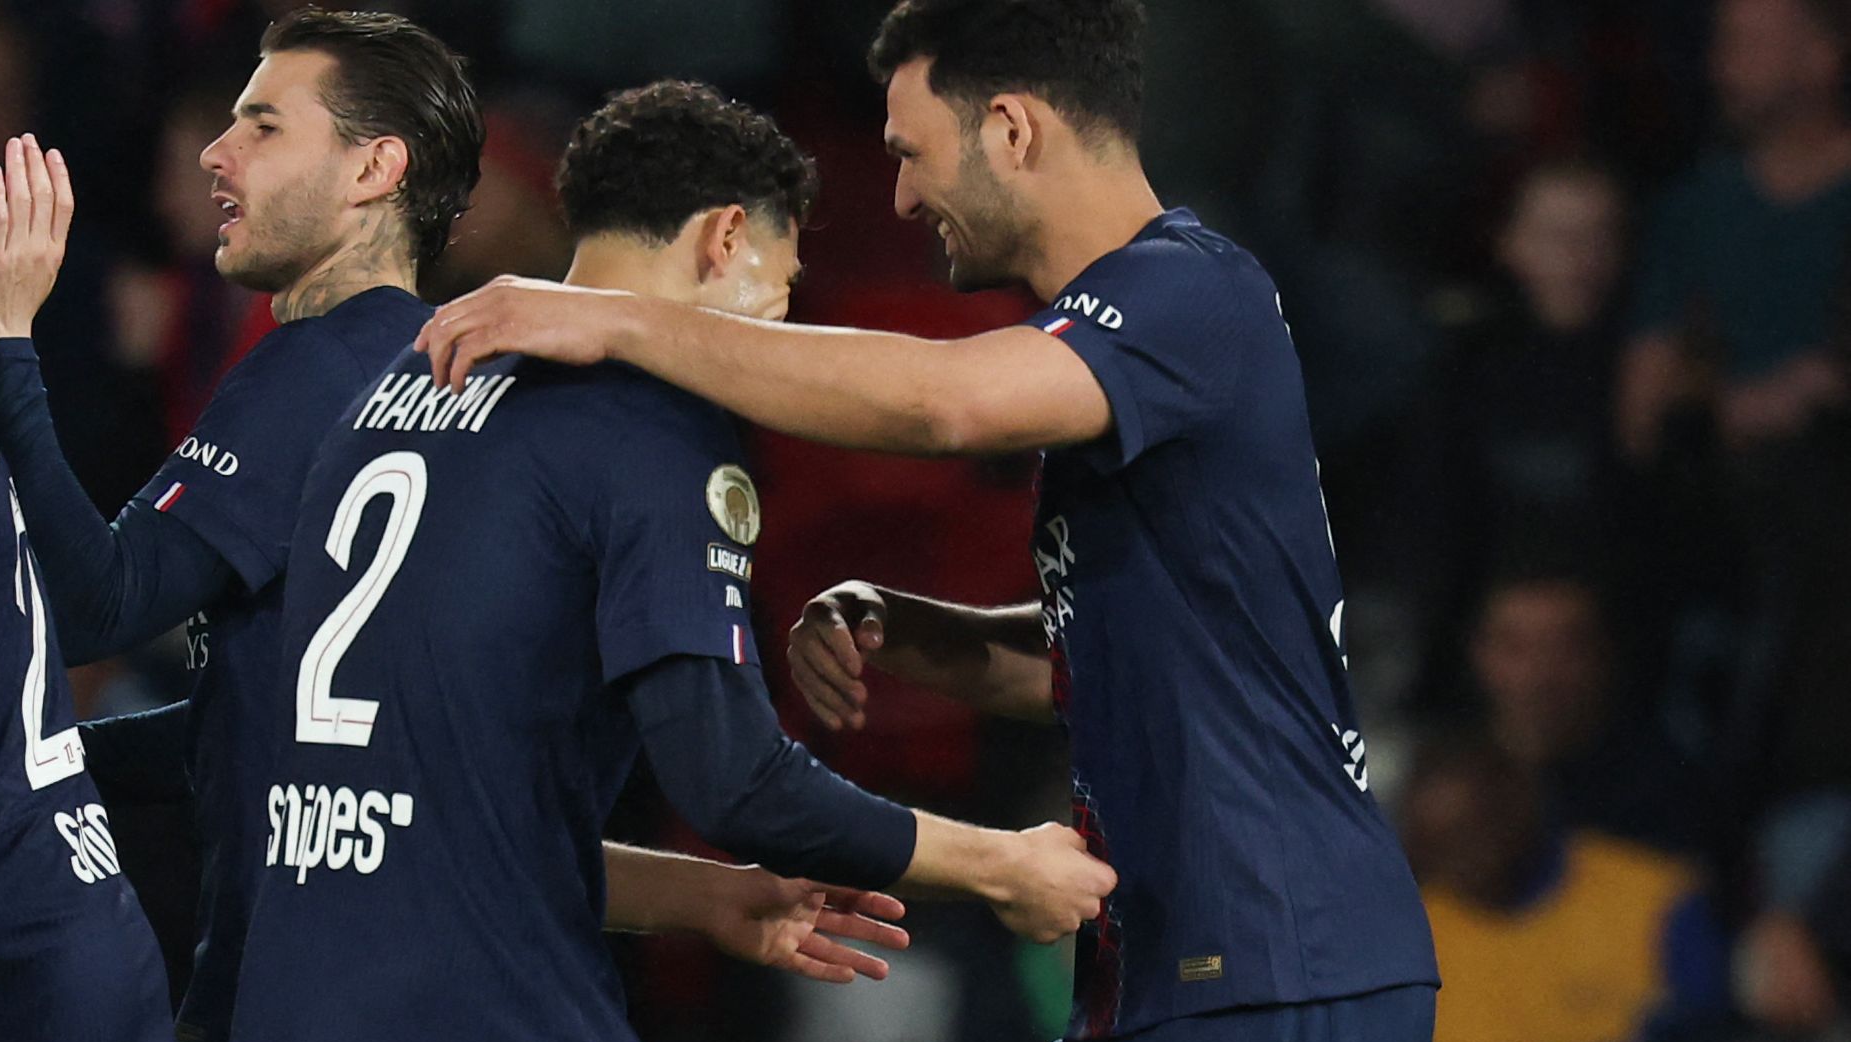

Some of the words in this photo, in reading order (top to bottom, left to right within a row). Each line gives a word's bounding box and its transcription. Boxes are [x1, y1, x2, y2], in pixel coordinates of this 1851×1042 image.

[353, 373, 516, 433] HAKIMI
[175, 436, 239, 476] OND
[296, 451, 428, 746] 2
